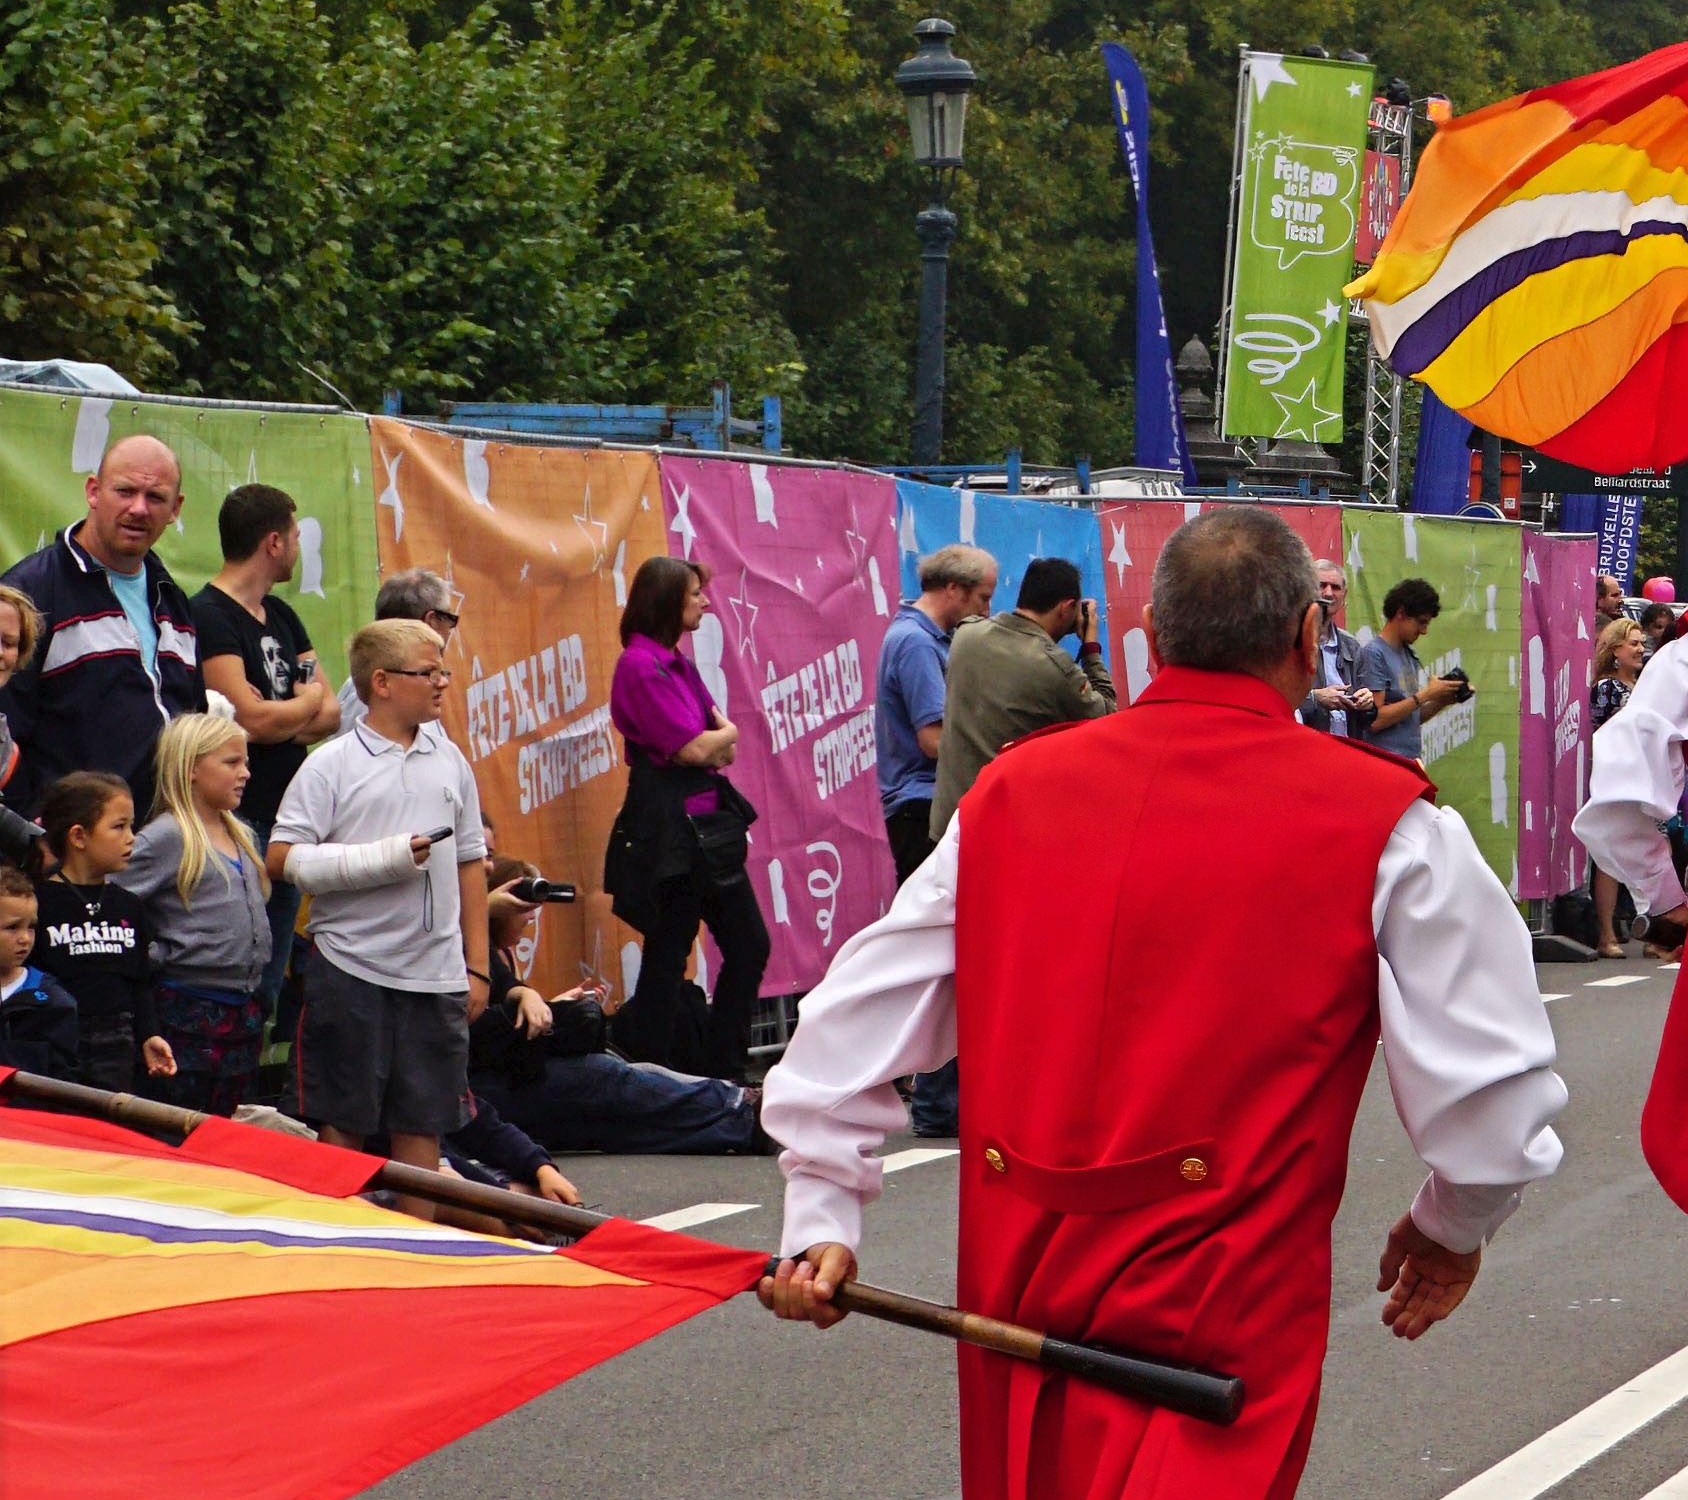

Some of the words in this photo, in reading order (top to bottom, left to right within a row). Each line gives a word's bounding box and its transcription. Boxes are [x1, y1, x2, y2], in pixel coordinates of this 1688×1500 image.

[1284, 181, 1298, 197] de
[1299, 182, 1310, 198] la
[1311, 171, 1338, 196] BD
[1271, 194, 1323, 223] STRIP
[1285, 220, 1325, 245] feest
[1594, 476, 1671, 489] Belliardstraat
[466, 655, 511, 762] FÊTE
[507, 660, 537, 736] DE
[530, 646, 560, 725] LA
[557, 633, 587, 713] BD
[799, 663, 824, 732] DE
[817, 650, 845, 720] LA
[836, 638, 863, 710] BD
[518, 703, 617, 815] STRIPFEEST
[46, 921, 135, 948] Making
[69, 940, 123, 956] fashion
